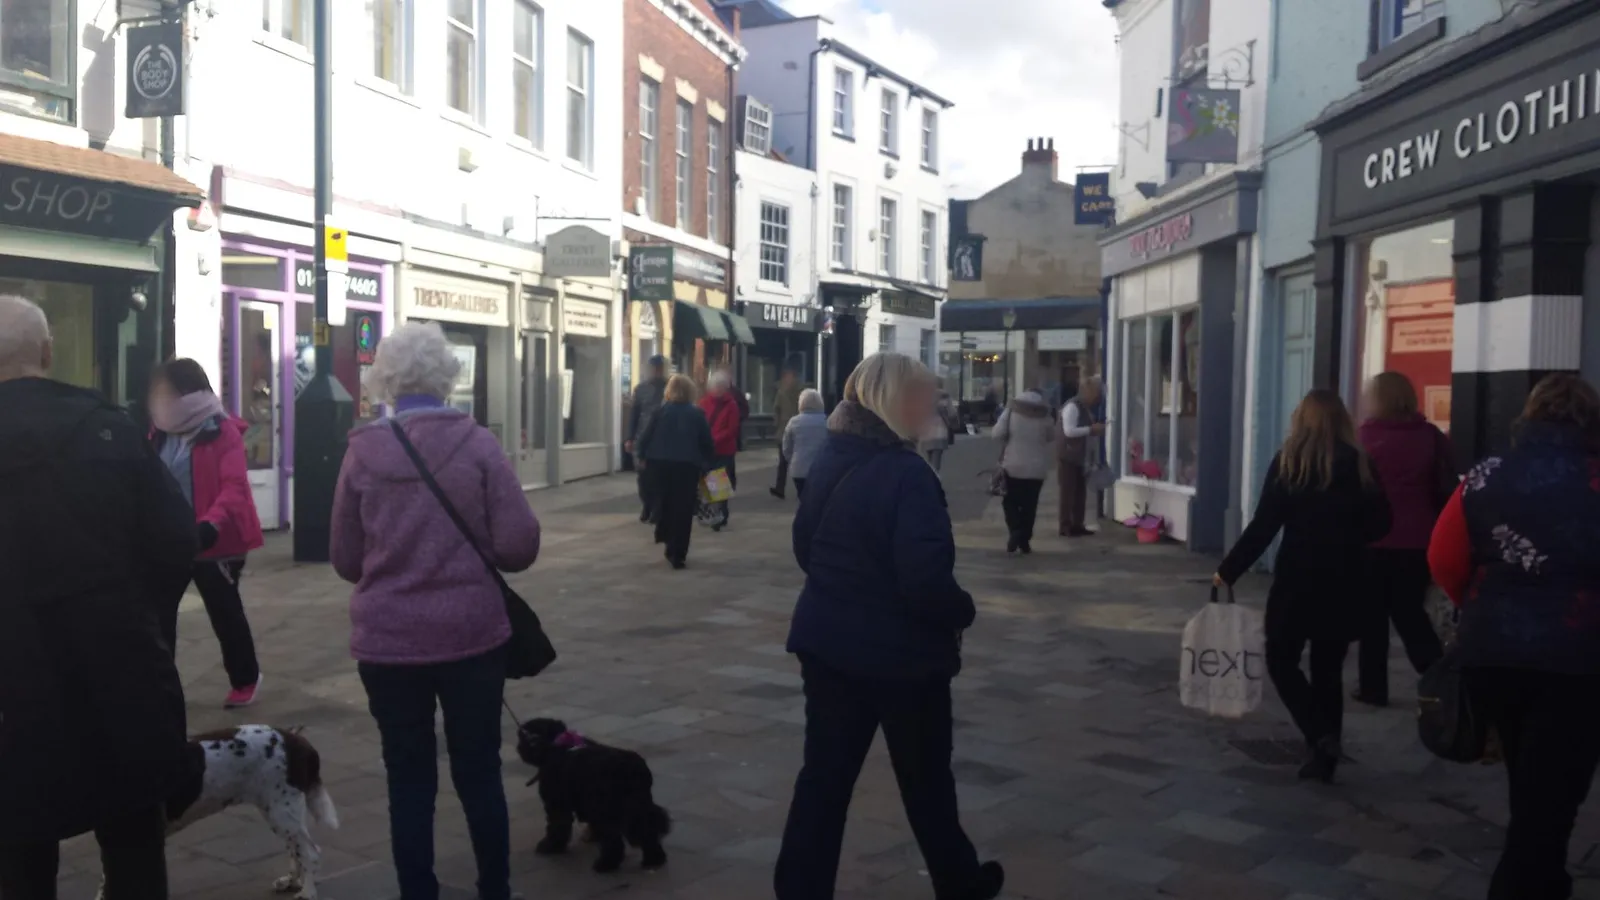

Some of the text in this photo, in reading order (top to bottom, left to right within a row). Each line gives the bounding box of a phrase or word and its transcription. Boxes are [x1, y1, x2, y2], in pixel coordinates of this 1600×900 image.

[141, 69, 168, 80] BODY
[142, 79, 167, 89] SHOP
[1364, 129, 1440, 188] CREW
[1083, 185, 1102, 196] WE
[4, 177, 112, 222] SHOP
[561, 245, 595, 255] TRENT
[763, 304, 808, 324] CAVEMAN
[1184, 647, 1263, 680] next
